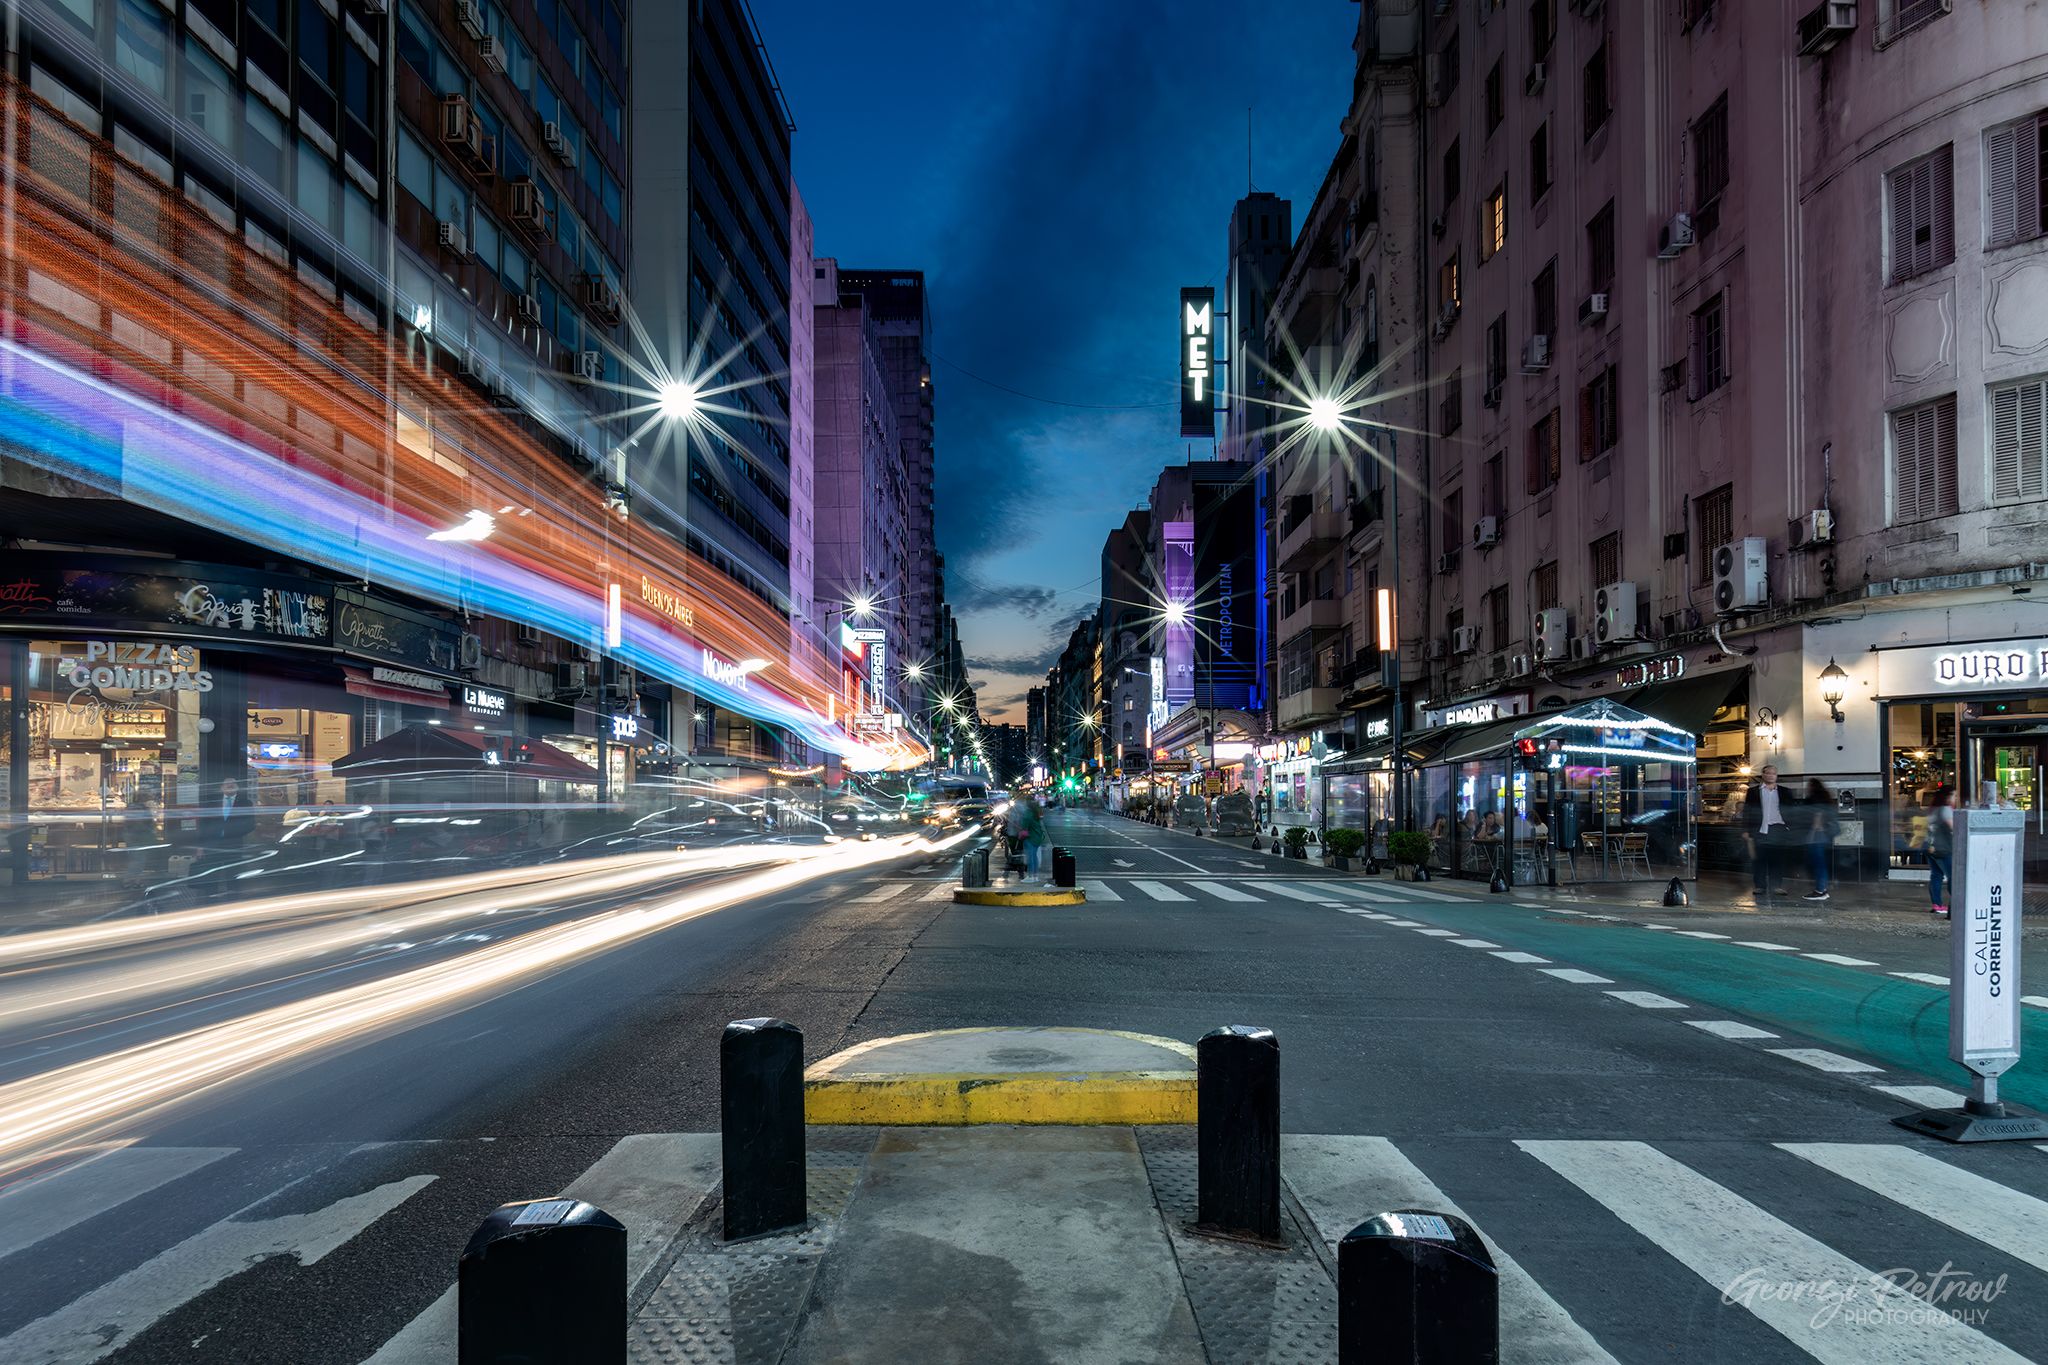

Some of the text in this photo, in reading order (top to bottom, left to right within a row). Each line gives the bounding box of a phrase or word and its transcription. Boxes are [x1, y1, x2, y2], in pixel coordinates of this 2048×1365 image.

[1186, 301, 1210, 402] MET
[56, 598, 74, 606] café
[56, 605, 92, 614] comidas
[674, 597, 693, 627] AIRES
[1219, 563, 1233, 657] METROPOLITAN
[86, 640, 196, 668] PIZZAS
[1940, 652, 2024, 680] OURO
[68, 665, 214, 693] COMIDAS
[465, 687, 505, 710] La Nueve
[1974, 907, 1988, 976] CALLE
[1990, 884, 2002, 998] CORRIENTES
